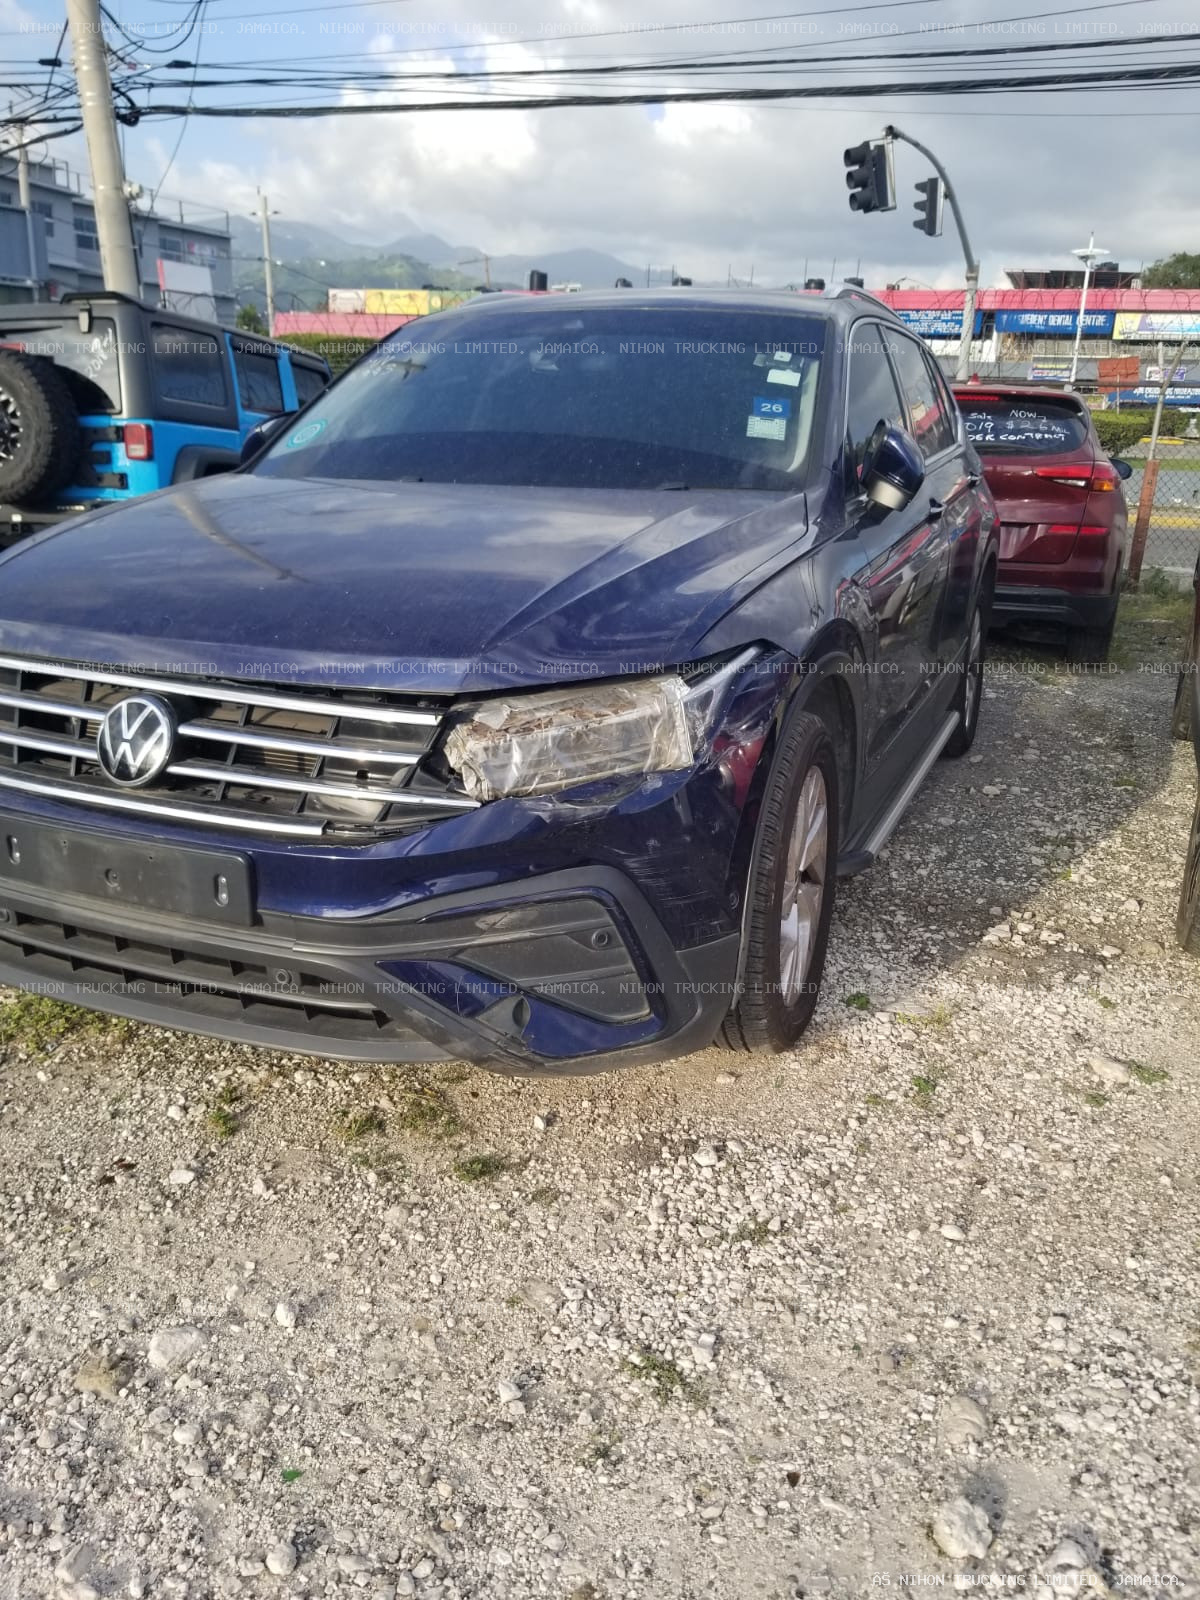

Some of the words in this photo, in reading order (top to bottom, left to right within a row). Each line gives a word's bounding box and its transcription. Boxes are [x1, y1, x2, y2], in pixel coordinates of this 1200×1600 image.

[761, 402, 783, 413] 26
[964, 421, 994, 433] 019
[968, 433, 996, 441] DER
